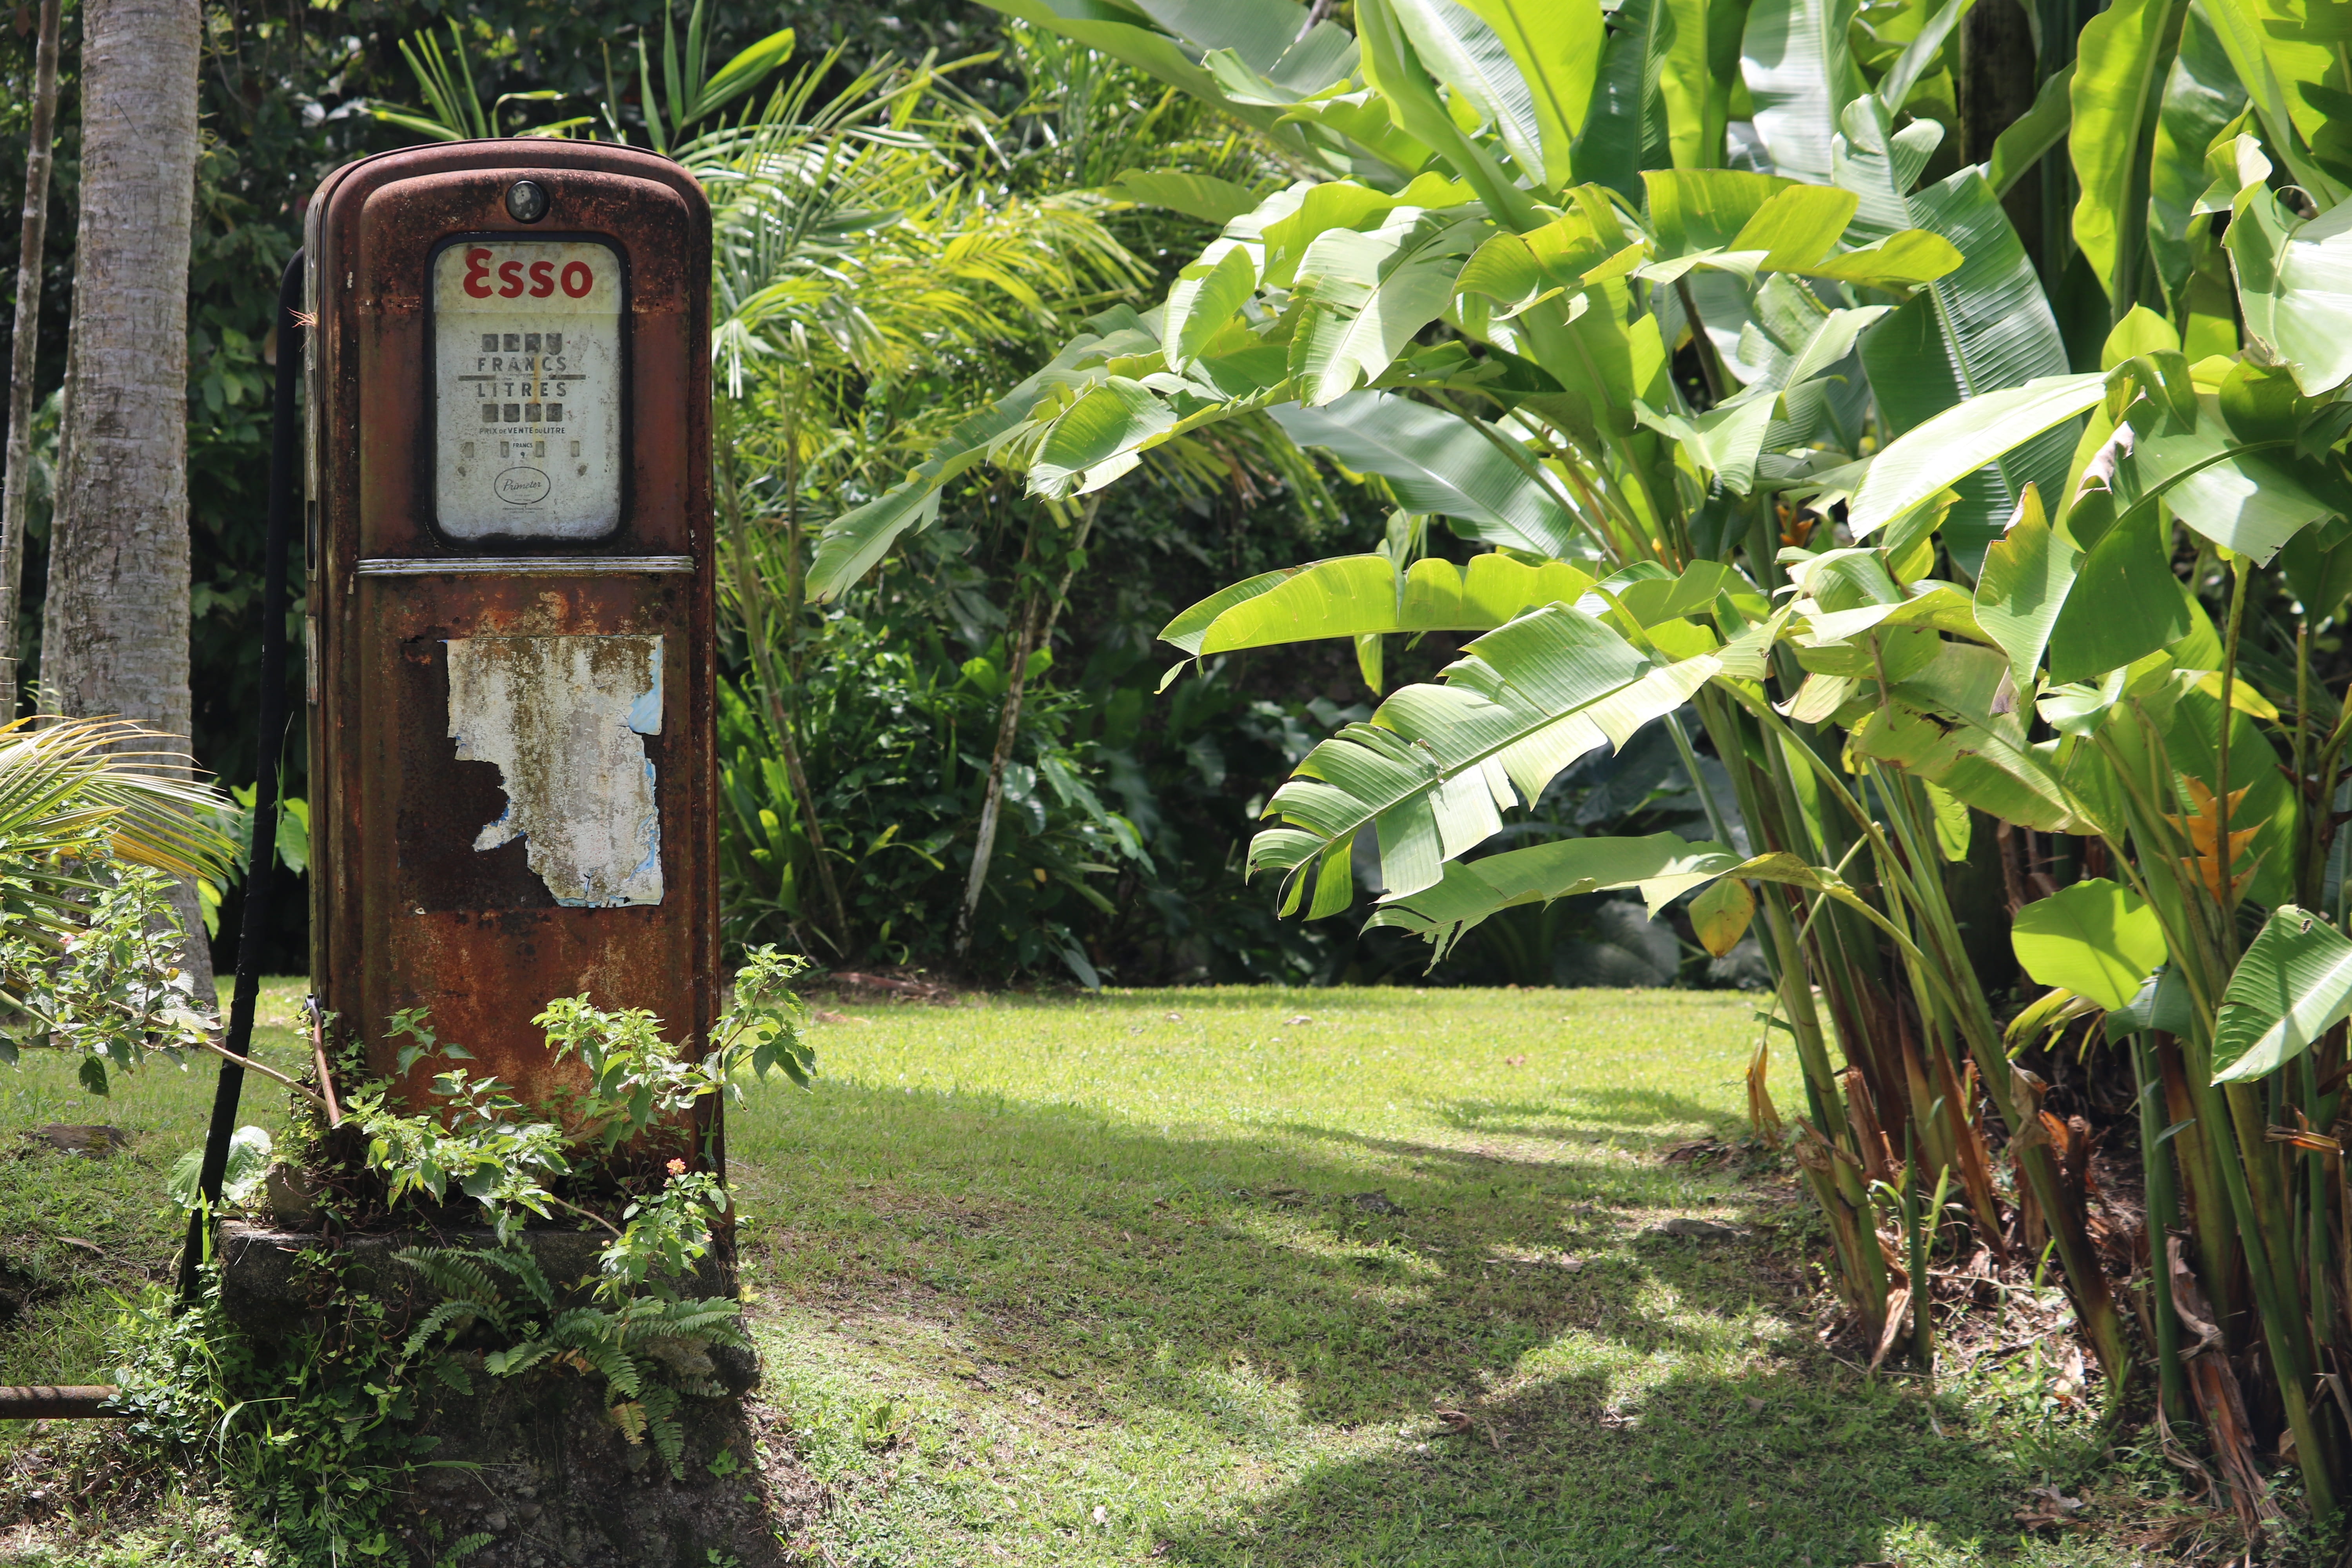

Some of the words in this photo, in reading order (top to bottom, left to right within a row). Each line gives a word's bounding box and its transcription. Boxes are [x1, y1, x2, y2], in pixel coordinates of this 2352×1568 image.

[463, 248, 593, 299] Esso
[478, 356, 566, 372] FRANCS
[478, 382, 566, 397] LITRES
[503, 479, 541, 491] Primeter
